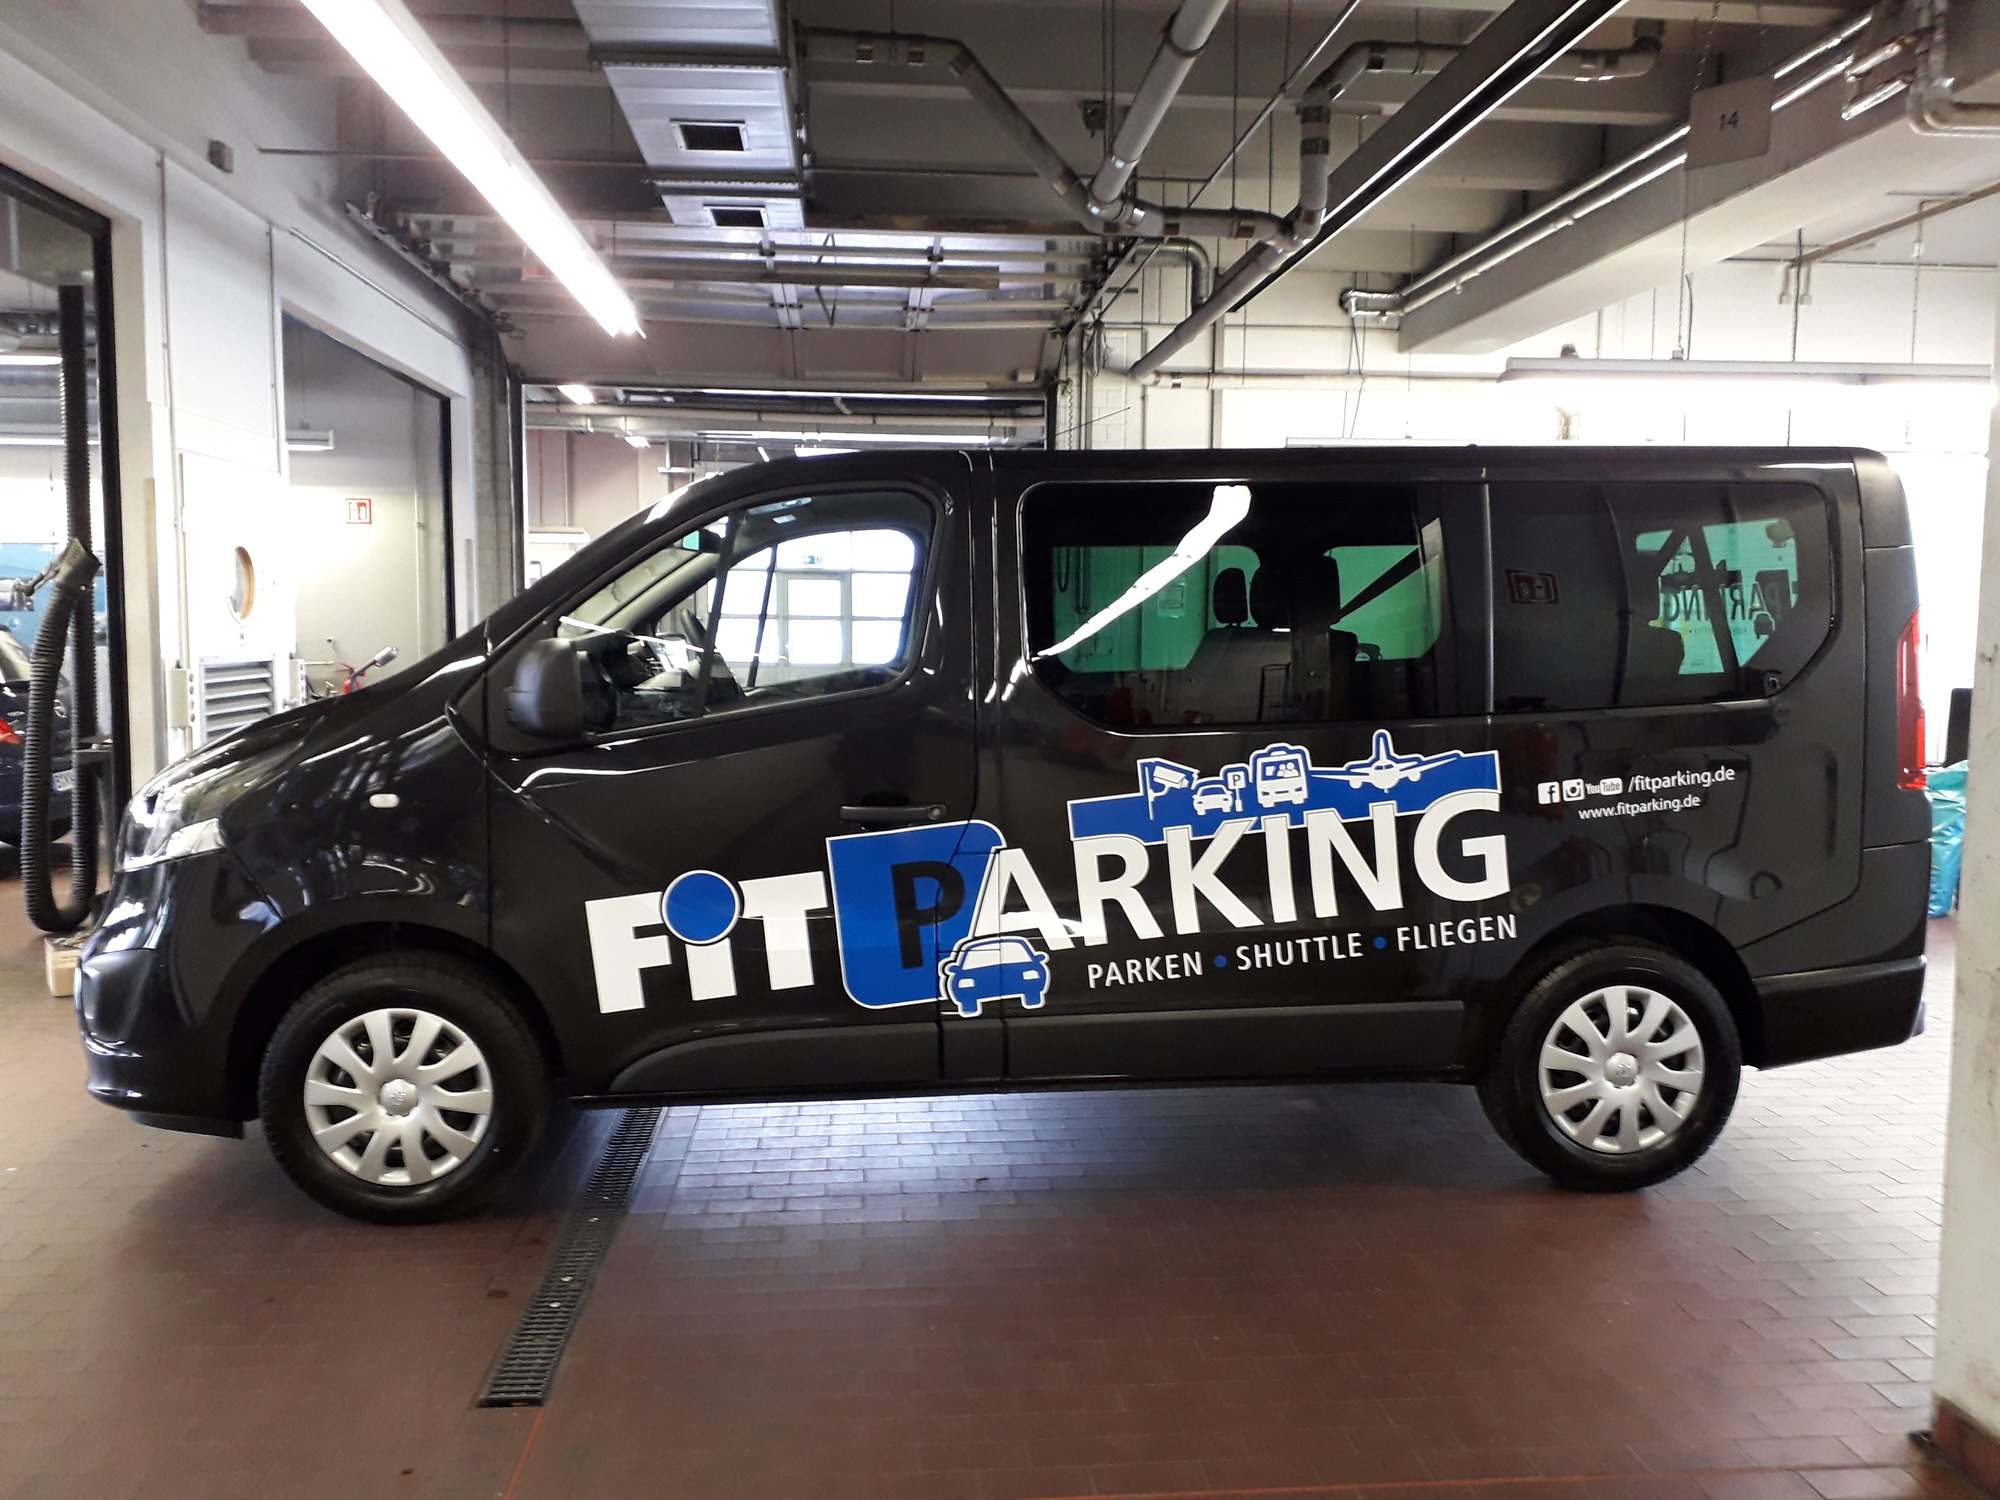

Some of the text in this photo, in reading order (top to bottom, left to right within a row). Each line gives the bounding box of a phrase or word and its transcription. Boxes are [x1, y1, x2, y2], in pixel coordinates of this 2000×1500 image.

[1719, 110, 1739, 130] 14
[1628, 766, 1735, 791] /fitparking.de
[1578, 794, 1701, 819] www.fitparking.de
[1087, 914, 1518, 989] PARKEN SHUTTLE FLIEGEN
